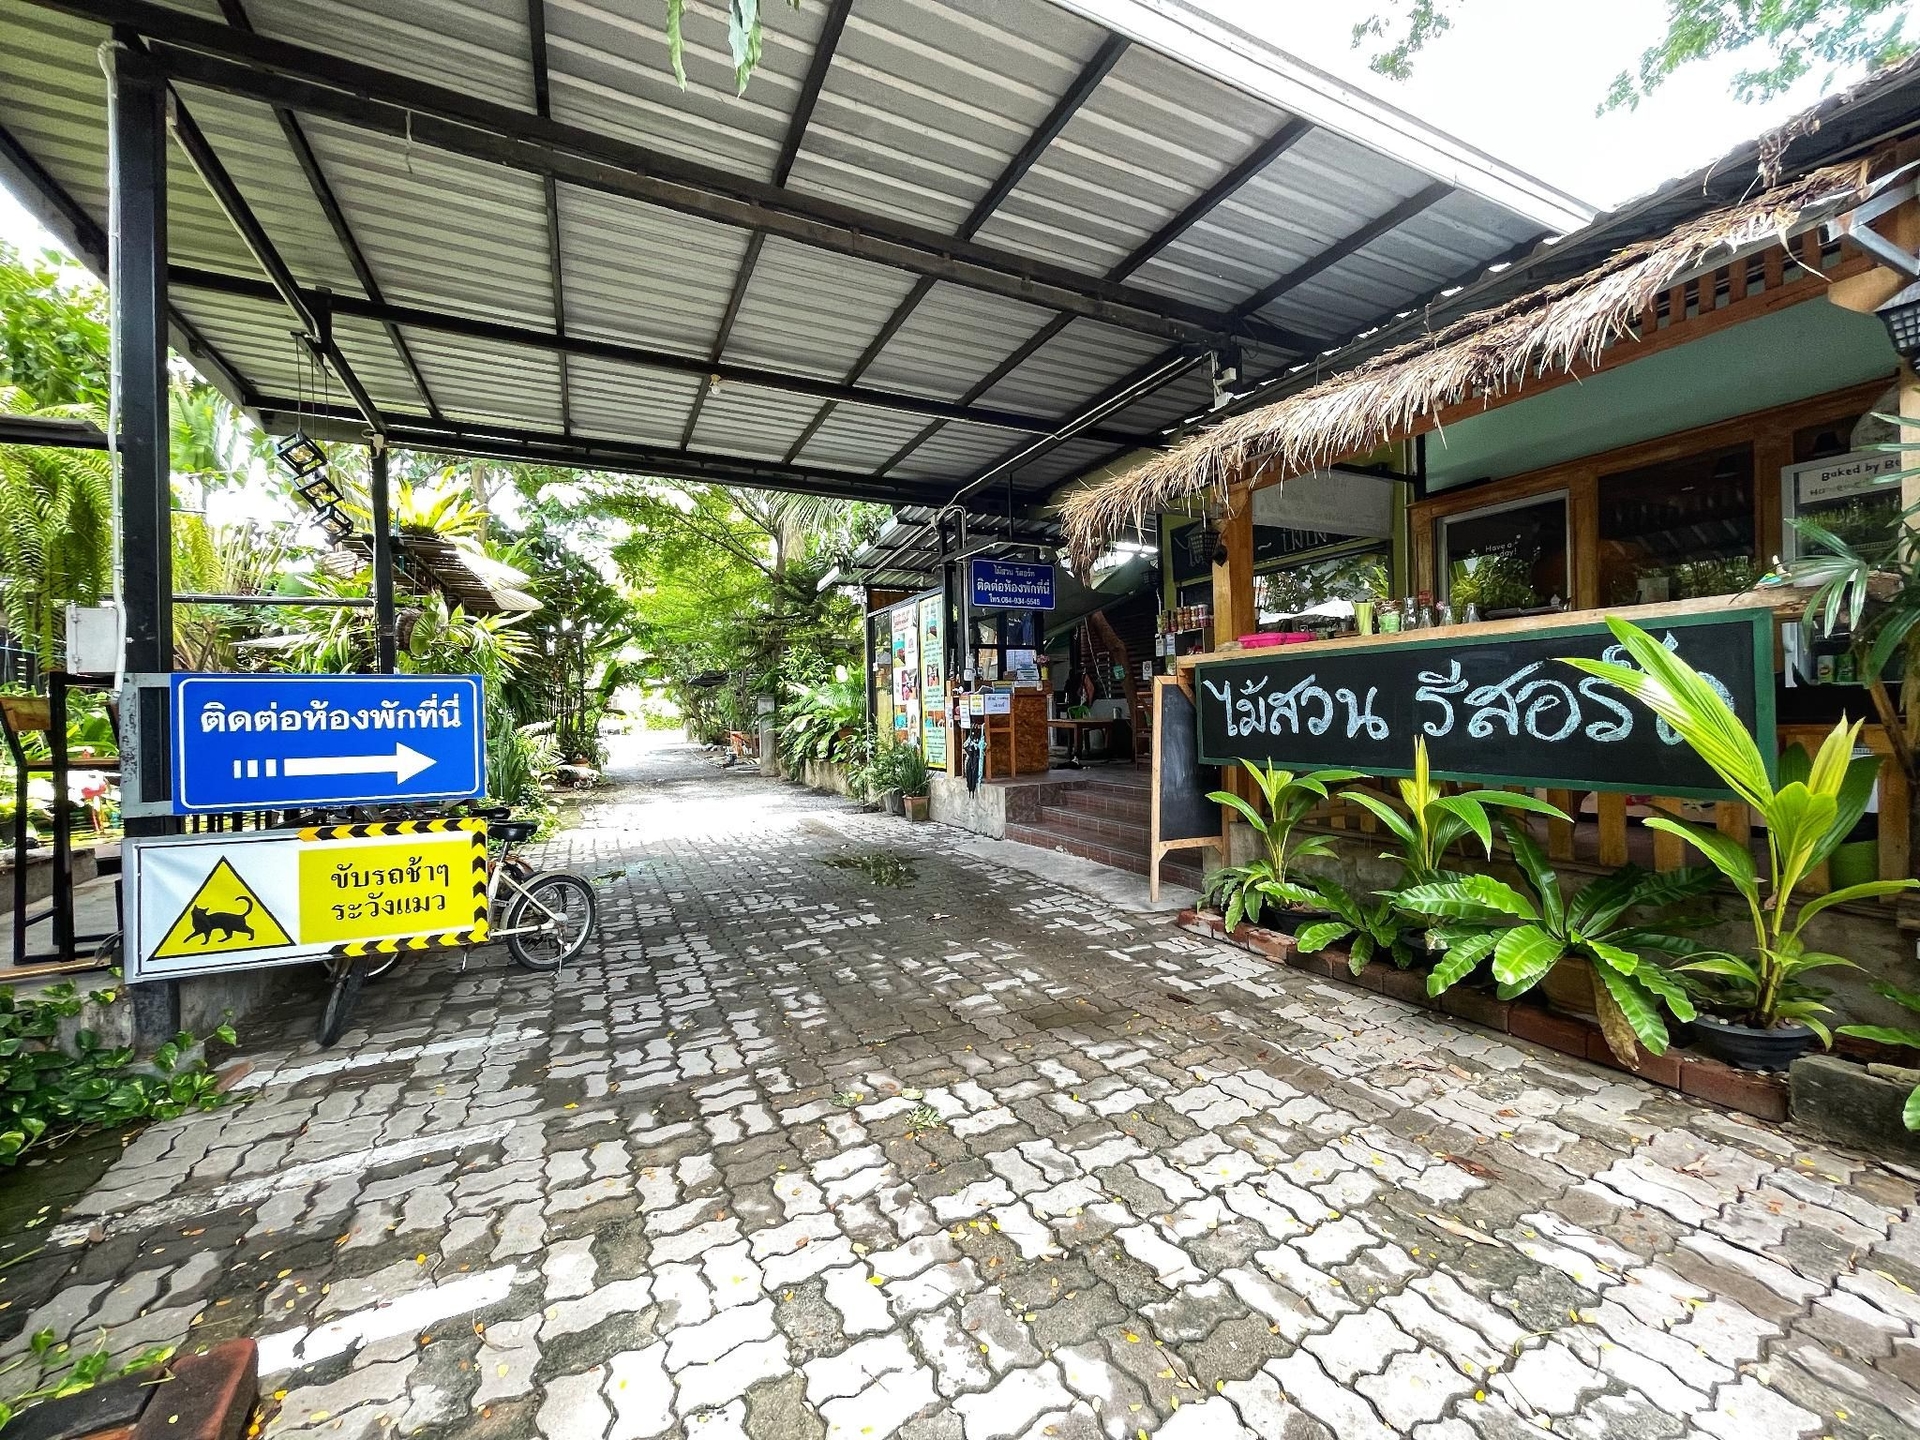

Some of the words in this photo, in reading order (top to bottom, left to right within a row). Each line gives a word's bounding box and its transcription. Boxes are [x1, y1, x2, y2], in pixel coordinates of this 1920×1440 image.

[1821, 465, 1860, 481] Baked
[1865, 463, 1880, 474] by
[1485, 543, 1506, 553] Have
[976, 577, 1050, 595] ติดต่อห้องพักที่นี่
[200, 694, 462, 732] ติดต่อห้องพักที่นี่
[1202, 673, 1389, 740] ไม้สวน
[330, 856, 449, 888] ขับรถช้าๆ
[331, 892, 446, 920] ระวังแมว
